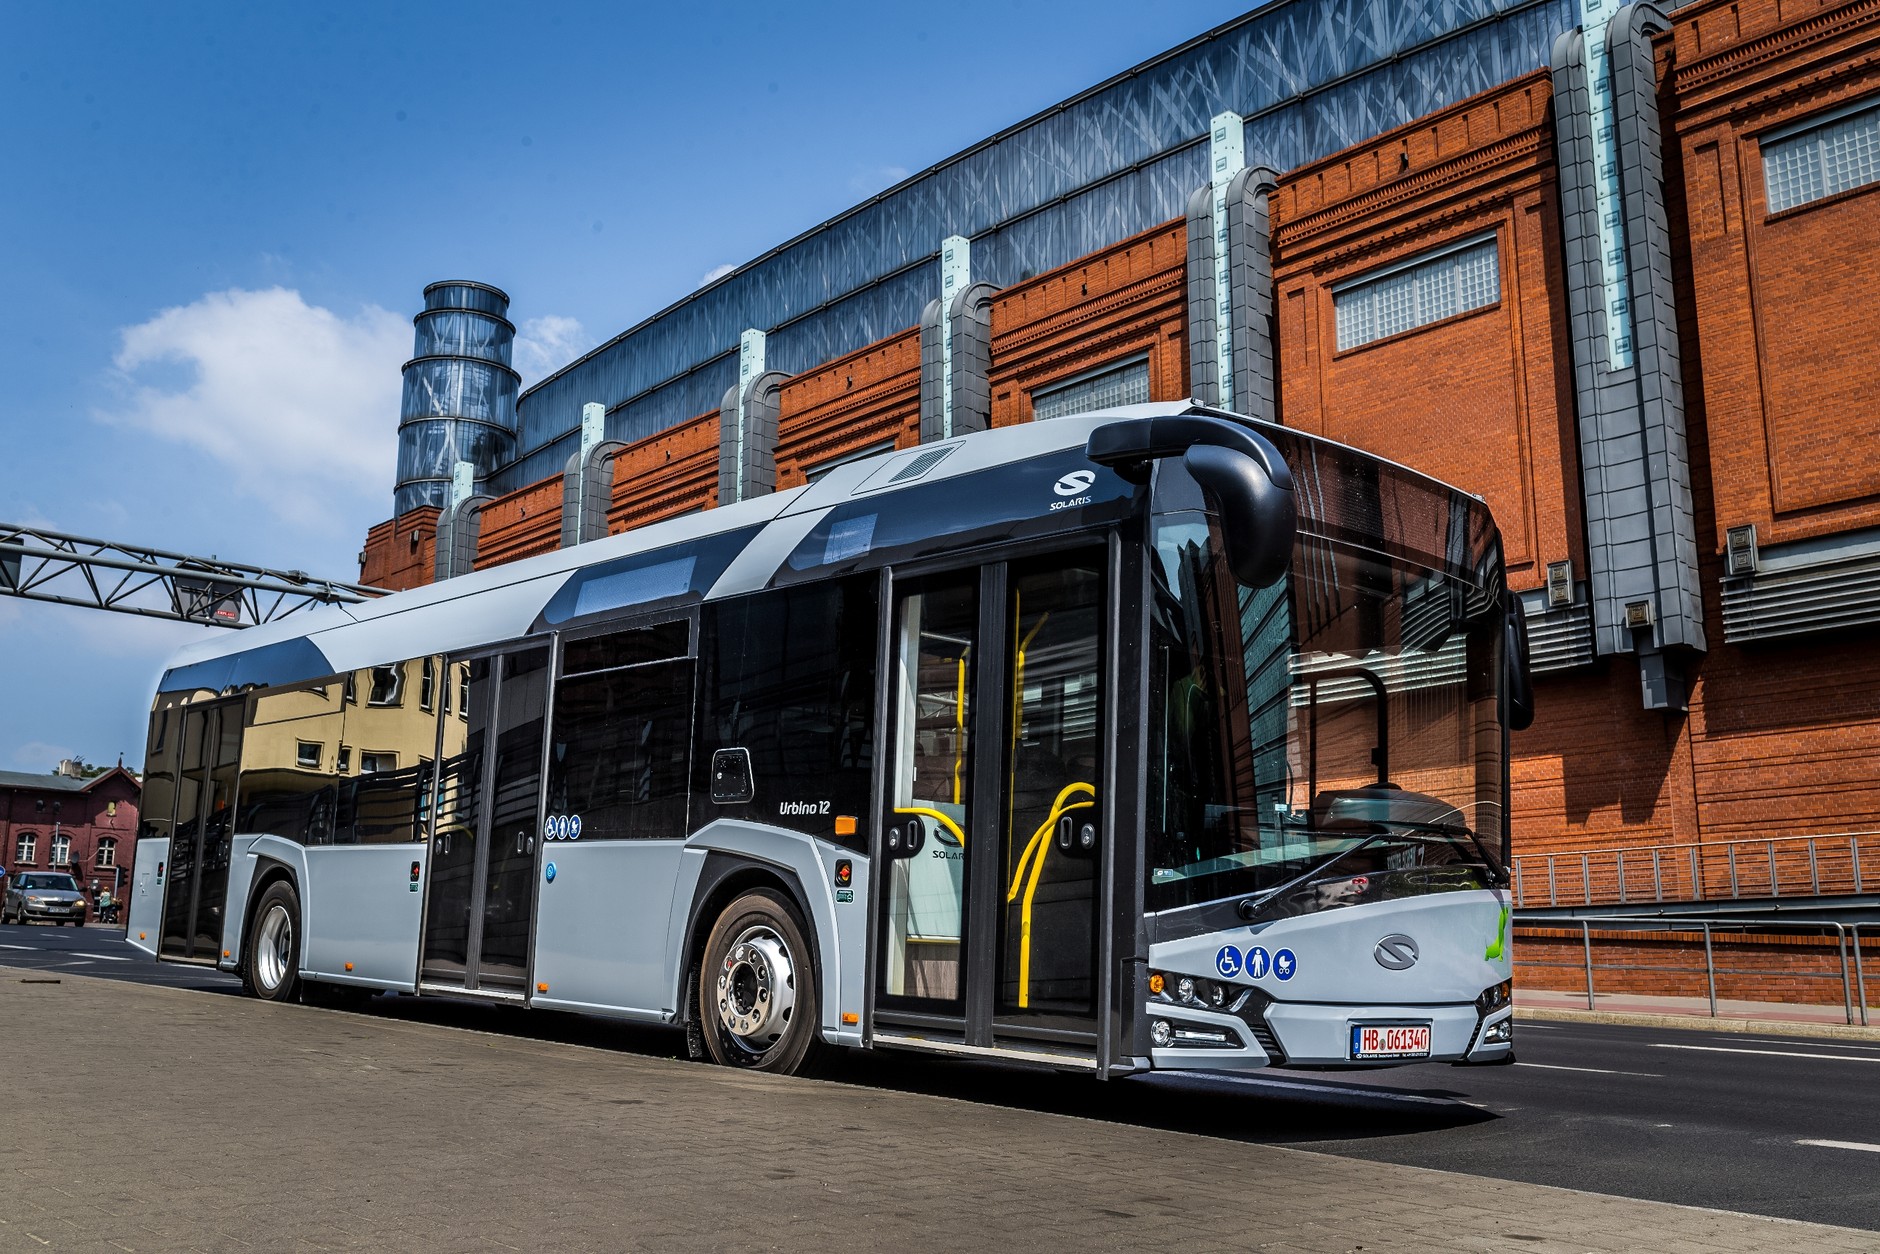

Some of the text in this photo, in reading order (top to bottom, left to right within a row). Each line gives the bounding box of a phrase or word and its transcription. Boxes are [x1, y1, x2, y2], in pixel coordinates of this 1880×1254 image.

[1049, 496, 1092, 511] SOLARIS
[779, 800, 831, 815] Urbino 12
[1363, 1029, 1427, 1051] HB 061340
